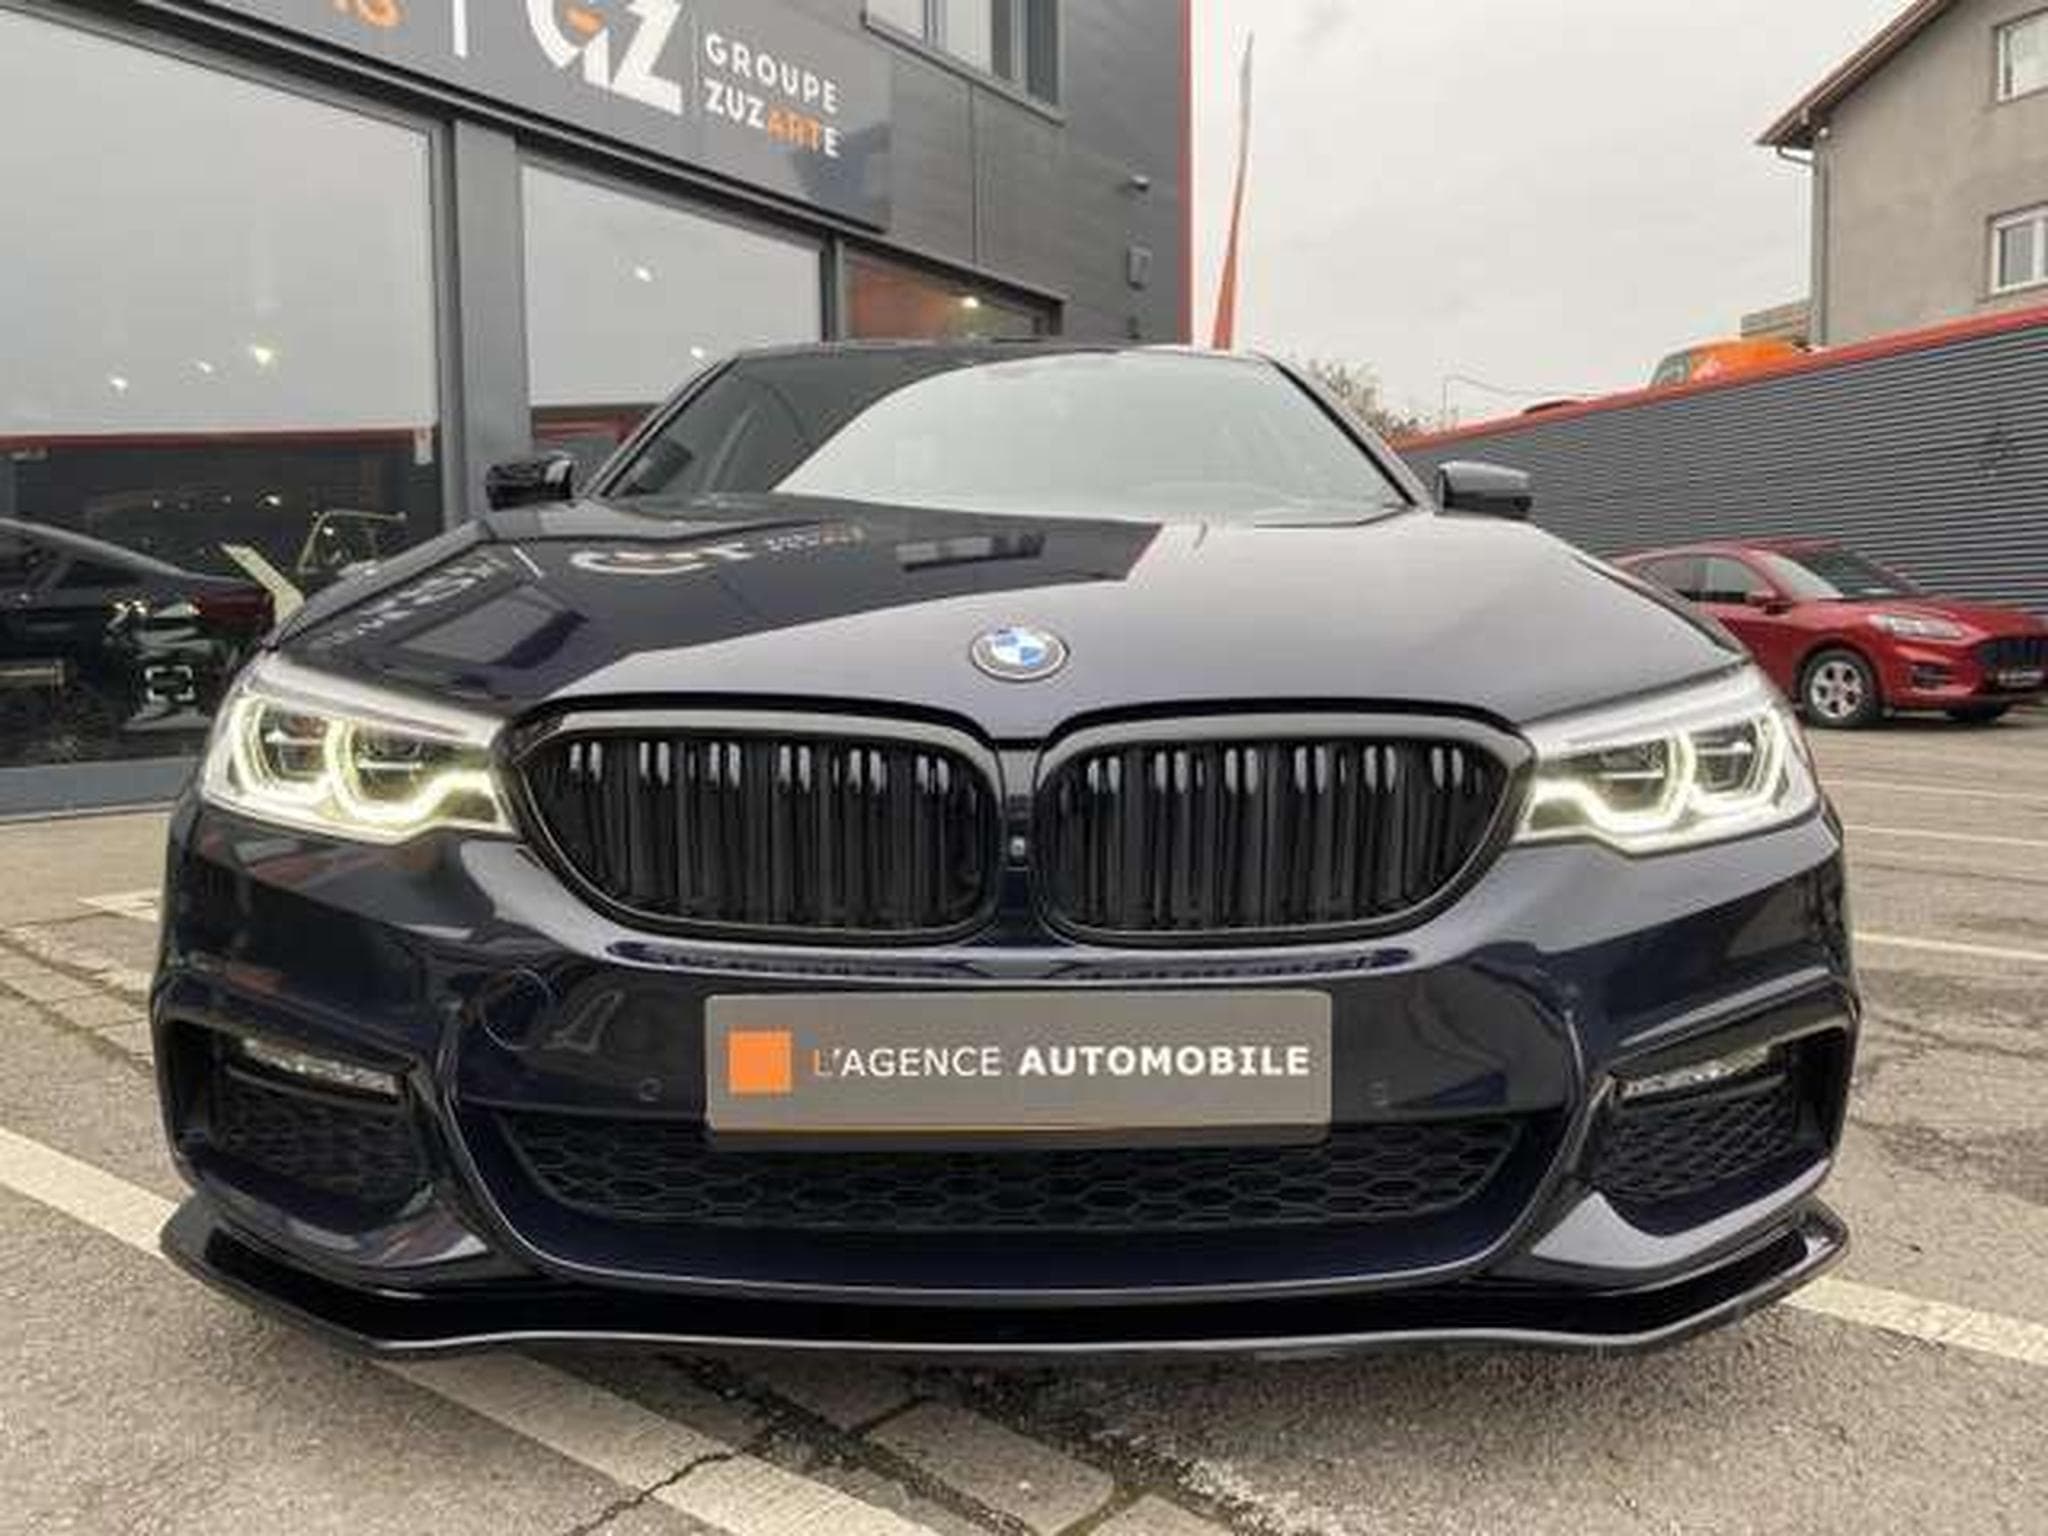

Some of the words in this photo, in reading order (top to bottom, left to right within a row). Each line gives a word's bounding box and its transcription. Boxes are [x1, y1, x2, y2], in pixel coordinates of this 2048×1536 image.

[705, 32, 838, 114] GROUPE
[813, 1047, 1000, 1077] L'AGENCE
[1018, 1045, 1310, 1077] AUTOMOBILE
